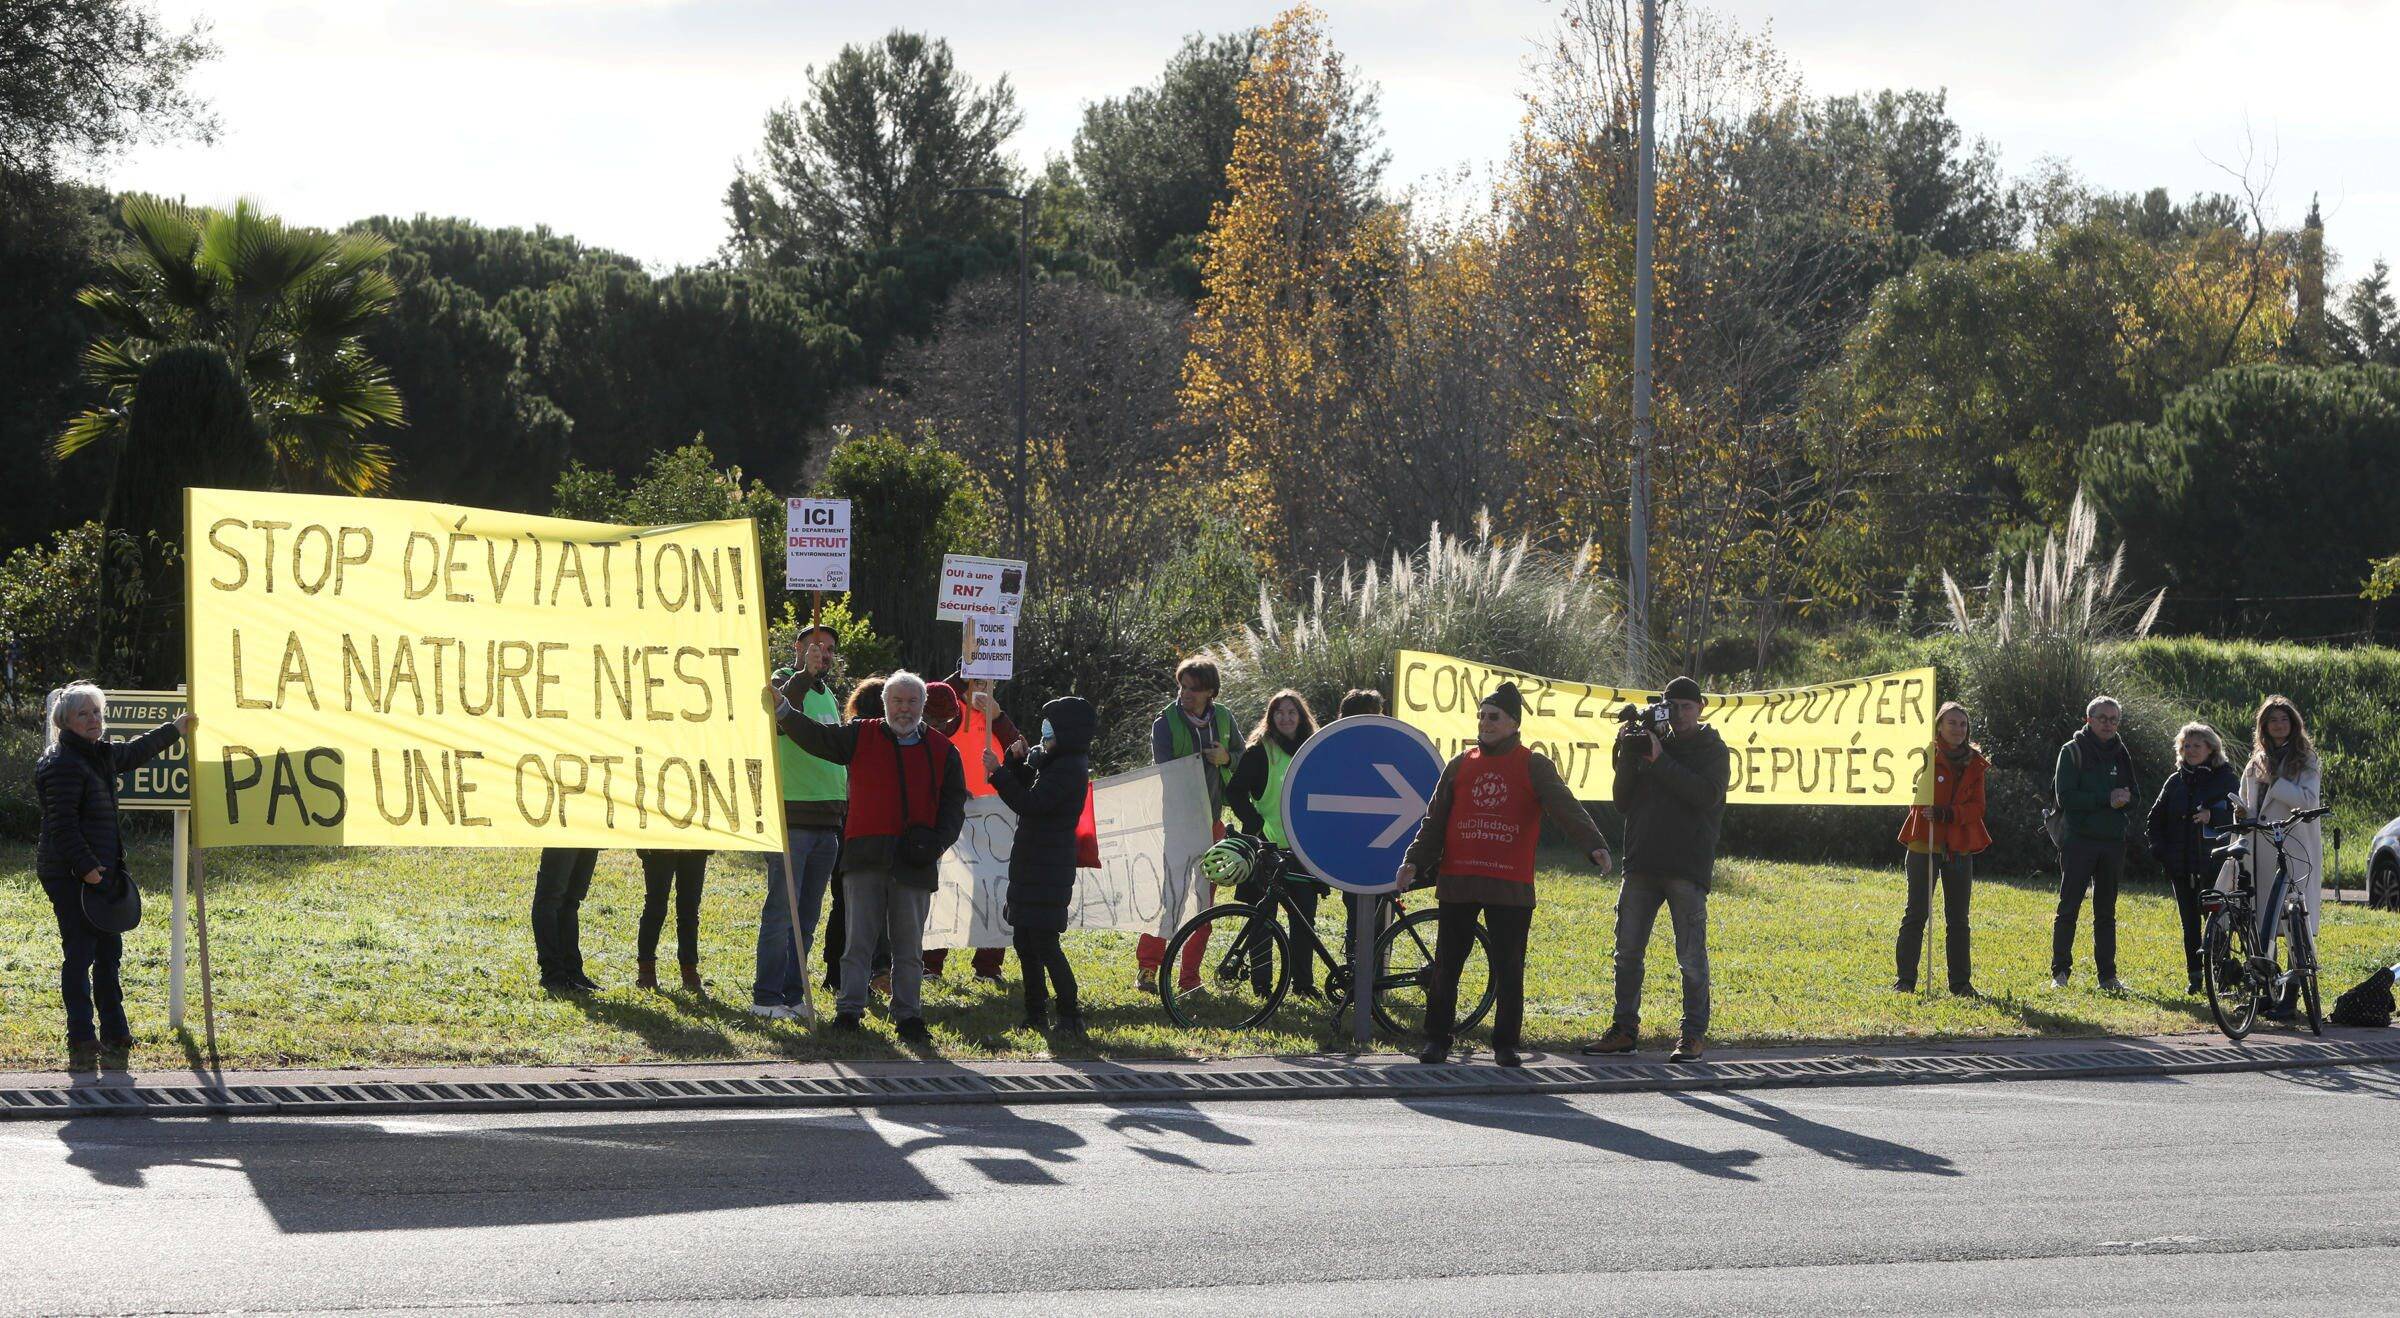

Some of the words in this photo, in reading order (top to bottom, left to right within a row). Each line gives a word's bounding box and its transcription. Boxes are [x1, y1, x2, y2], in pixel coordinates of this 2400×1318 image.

[804, 508, 834, 526] ICI
[789, 536, 848, 548] DETRUIT
[208, 518, 374, 595] STOP
[946, 568, 964, 578] OUI
[966, 571, 973, 579] à
[975, 572, 993, 580] une
[953, 584, 984, 597] RN7
[940, 601, 996, 613] sécurisée
[980, 624, 1005, 633] TOUCHE
[976, 638, 989, 646] PAS
[998, 638, 1007, 647] MA
[971, 652, 1012, 661] BIODIVERSITE
[233, 629, 320, 711] LA
[342, 634, 569, 718] NATURE
[593, 644, 740, 722] N'EST
[103, 706, 168, 719] ANTIBES
[222, 745, 348, 827] PAS
[371, 748, 492, 826] UNE
